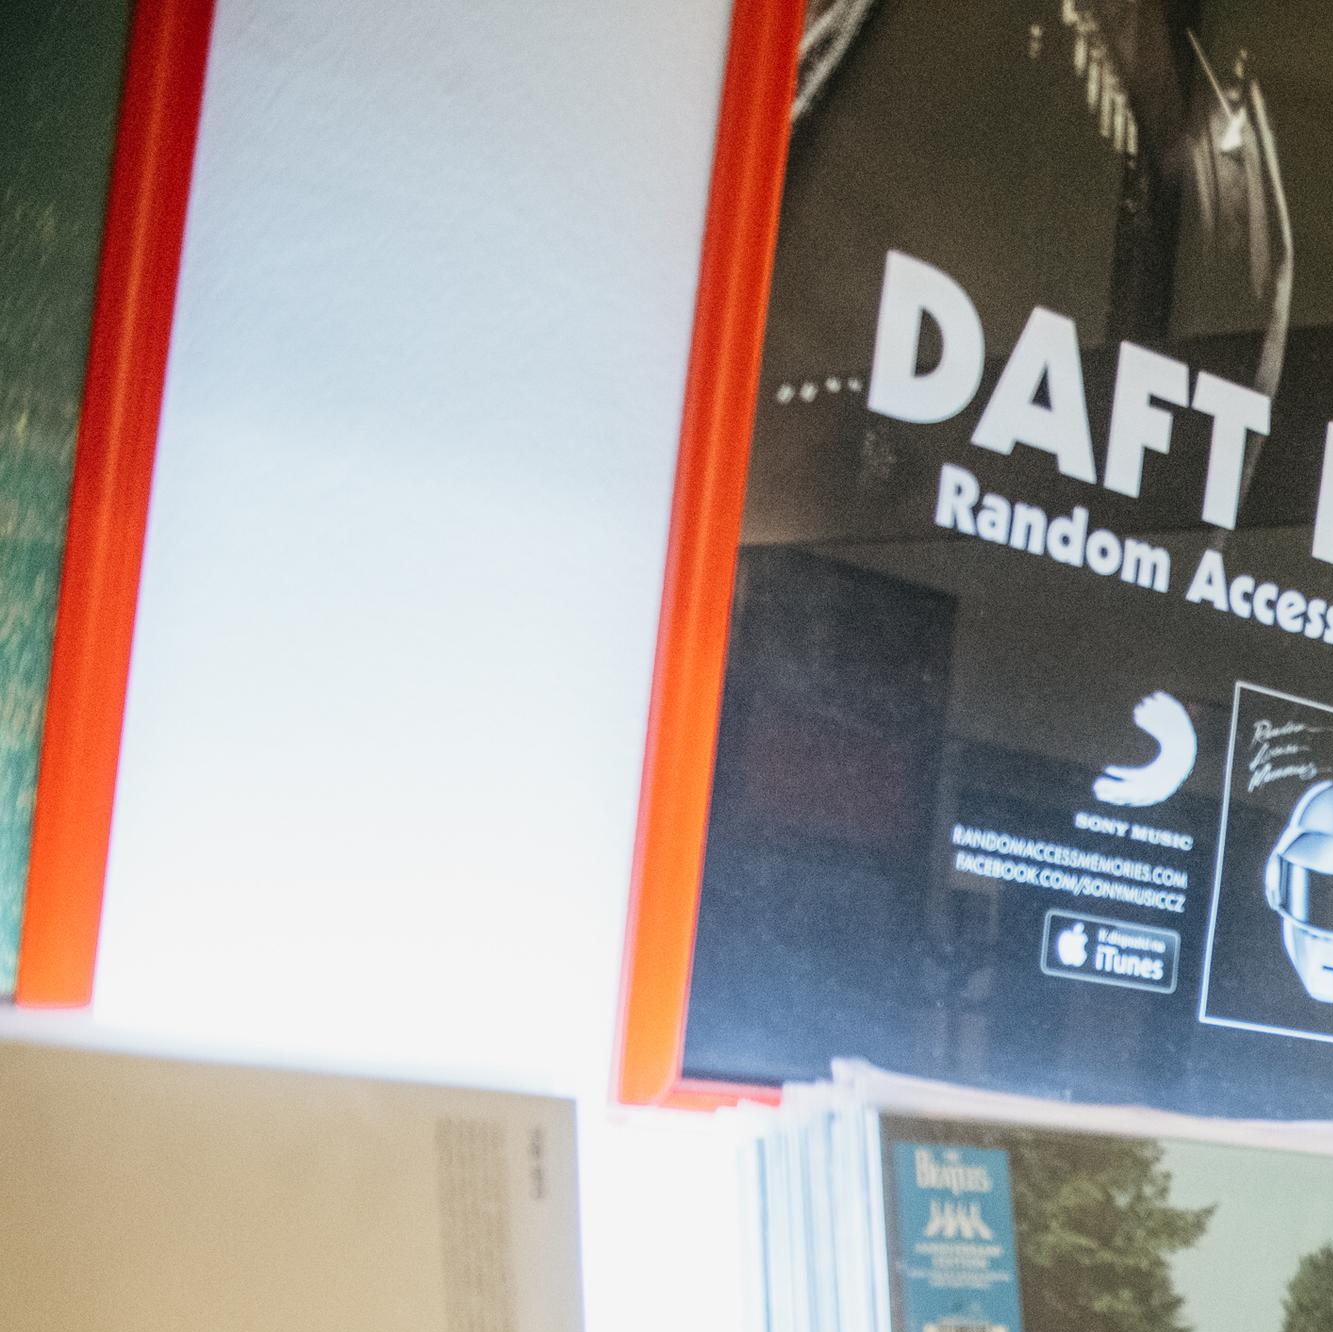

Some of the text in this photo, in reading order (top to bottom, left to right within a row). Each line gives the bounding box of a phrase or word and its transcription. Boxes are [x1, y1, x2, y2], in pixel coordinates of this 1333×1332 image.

[866, 250, 1271, 530] DAFT
[935, 463, 1170, 593] Random
[952, 823, 1189, 889] RANDOMACCESSMEMORIES.COM
[1074, 812, 1194, 851] SONY MUSIC
[1095, 944, 1165, 980] iTunes
